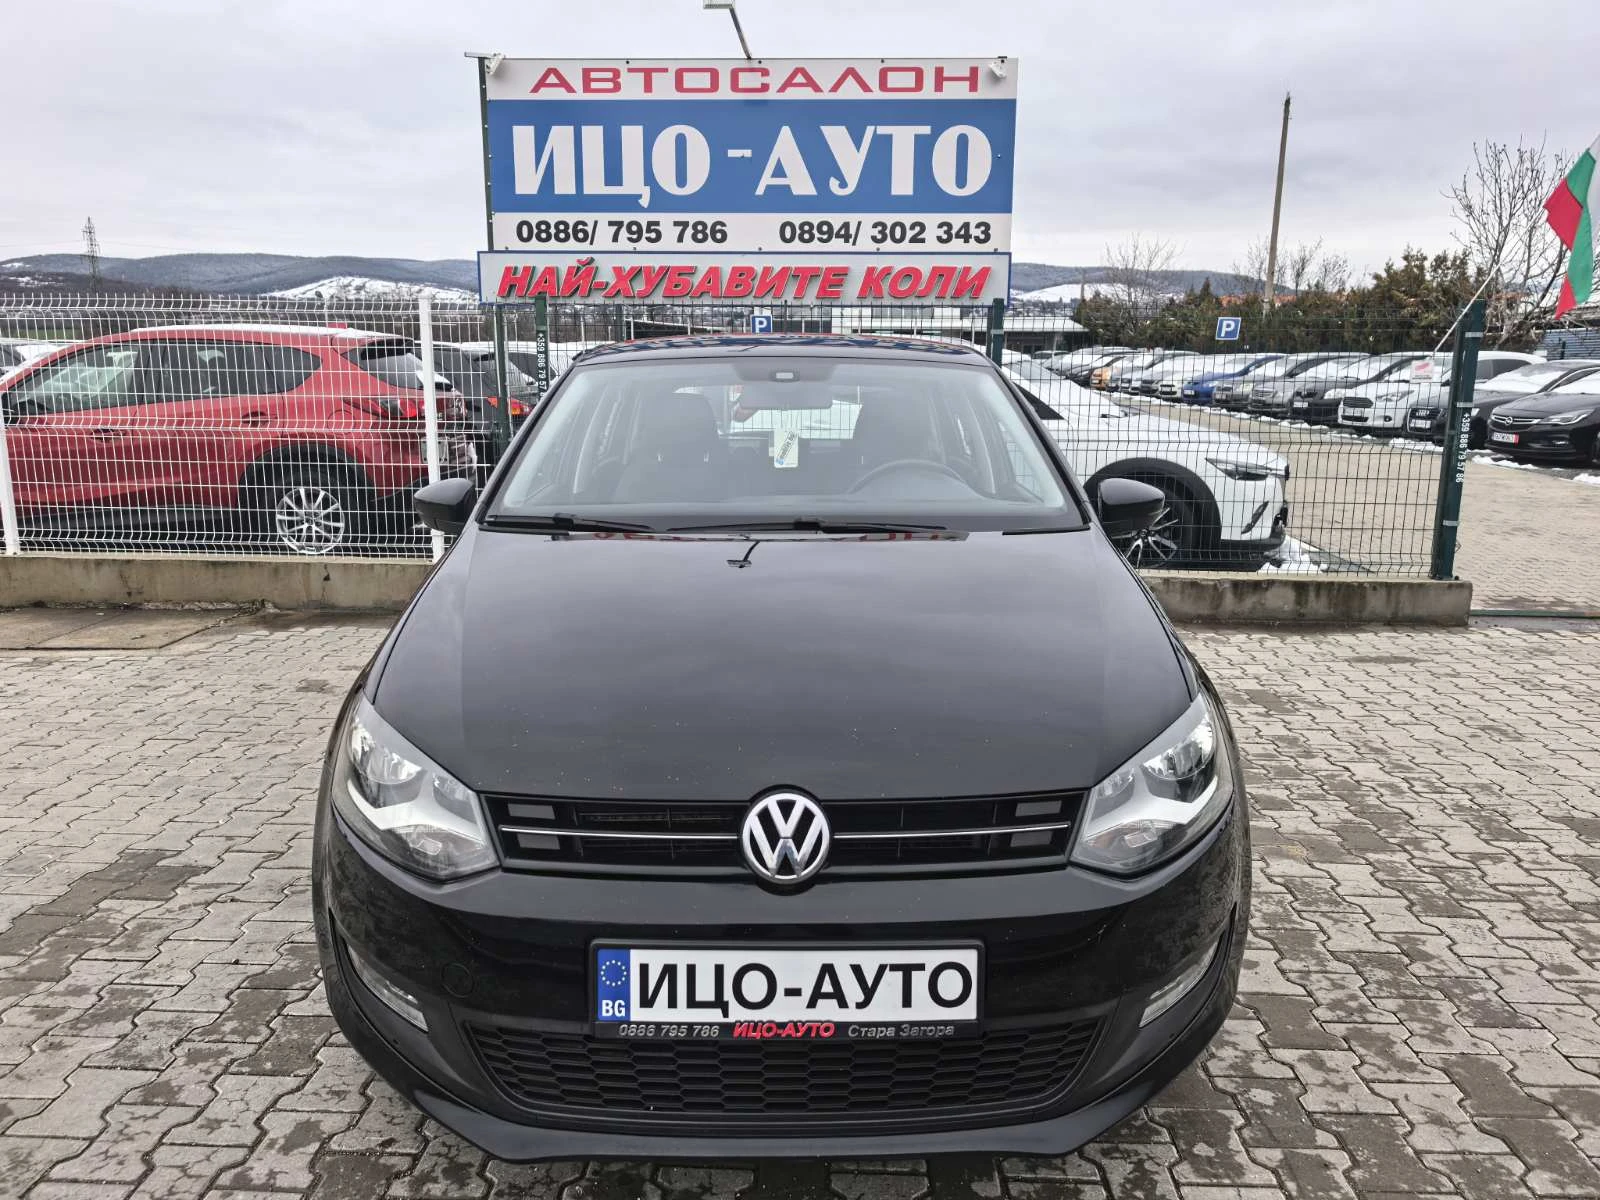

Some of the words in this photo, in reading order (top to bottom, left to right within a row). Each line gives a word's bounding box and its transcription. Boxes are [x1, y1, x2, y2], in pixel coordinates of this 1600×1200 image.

[530, 66, 979, 94] АВТОСАЛОН
[516, 220, 598, 245] 0886/
[608, 220, 662, 244] 795
[673, 220, 728, 244] 786
[779, 220, 862, 245] 0894/
[871, 220, 926, 244] 302
[936, 220, 992, 244] 343
[498, 256, 850, 299] НАЙ-ХУБАВИТЕ
[857, 265, 992, 299] КОЛИ
[754, 317, 768, 333] P
[1220, 320, 1236, 337] P
[638, 961, 973, 1019] ИЦО-АУТО
[601, 1000, 626, 1018] BG
[661, 1024, 688, 1038] 795
[692, 1025, 720, 1038] 786
[732, 1021, 836, 1040] ИЦО-АУТО
[848, 1025, 896, 1039] Стара
[900, 1023, 955, 1038] Загора
